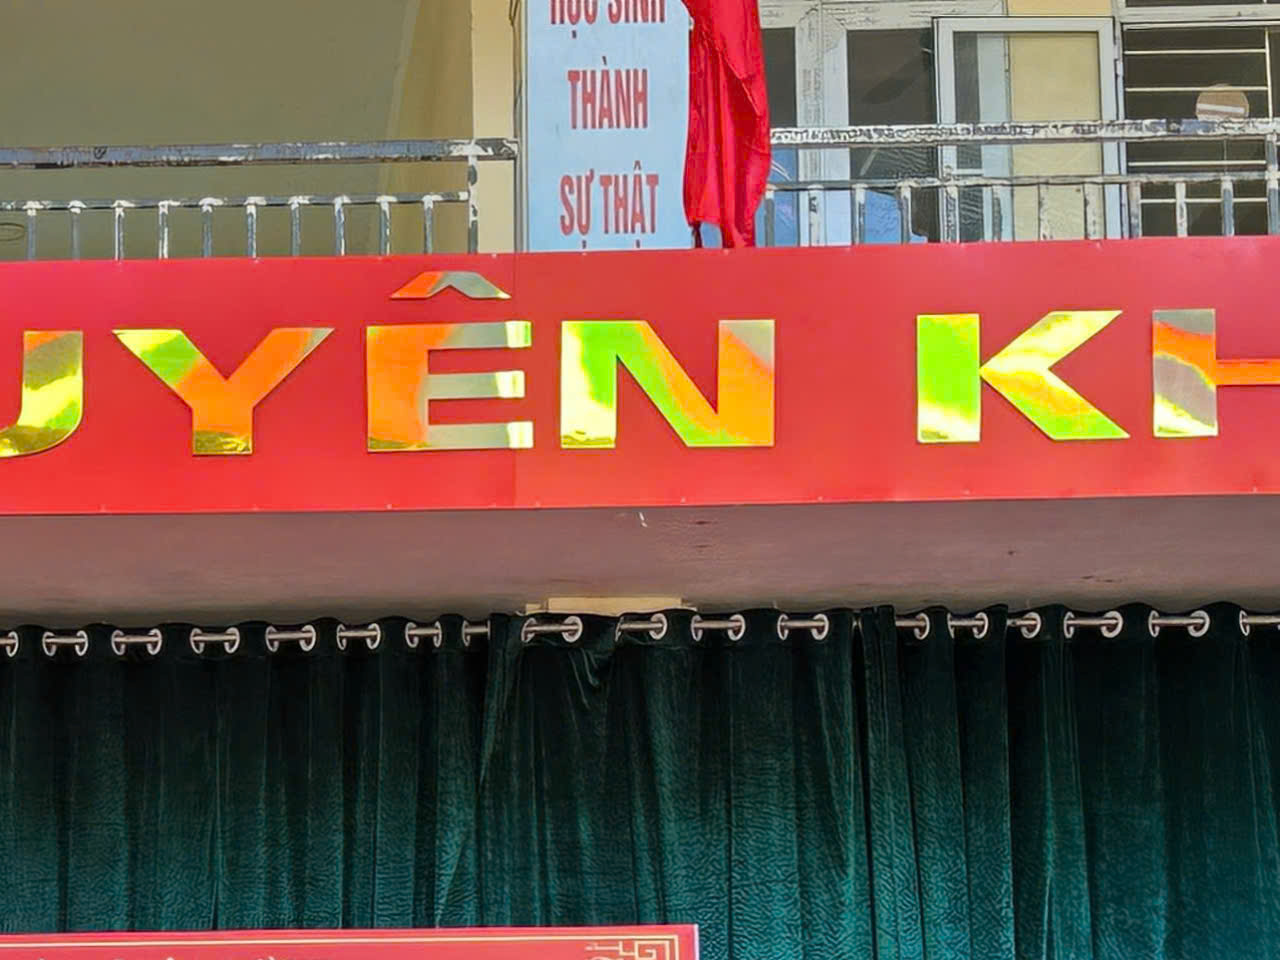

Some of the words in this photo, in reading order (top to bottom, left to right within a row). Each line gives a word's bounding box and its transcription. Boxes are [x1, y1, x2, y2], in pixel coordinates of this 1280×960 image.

[567, 56, 648, 129] THÀNH
[560, 168, 594, 248] SỰ
[599, 160, 659, 248] THẬT
